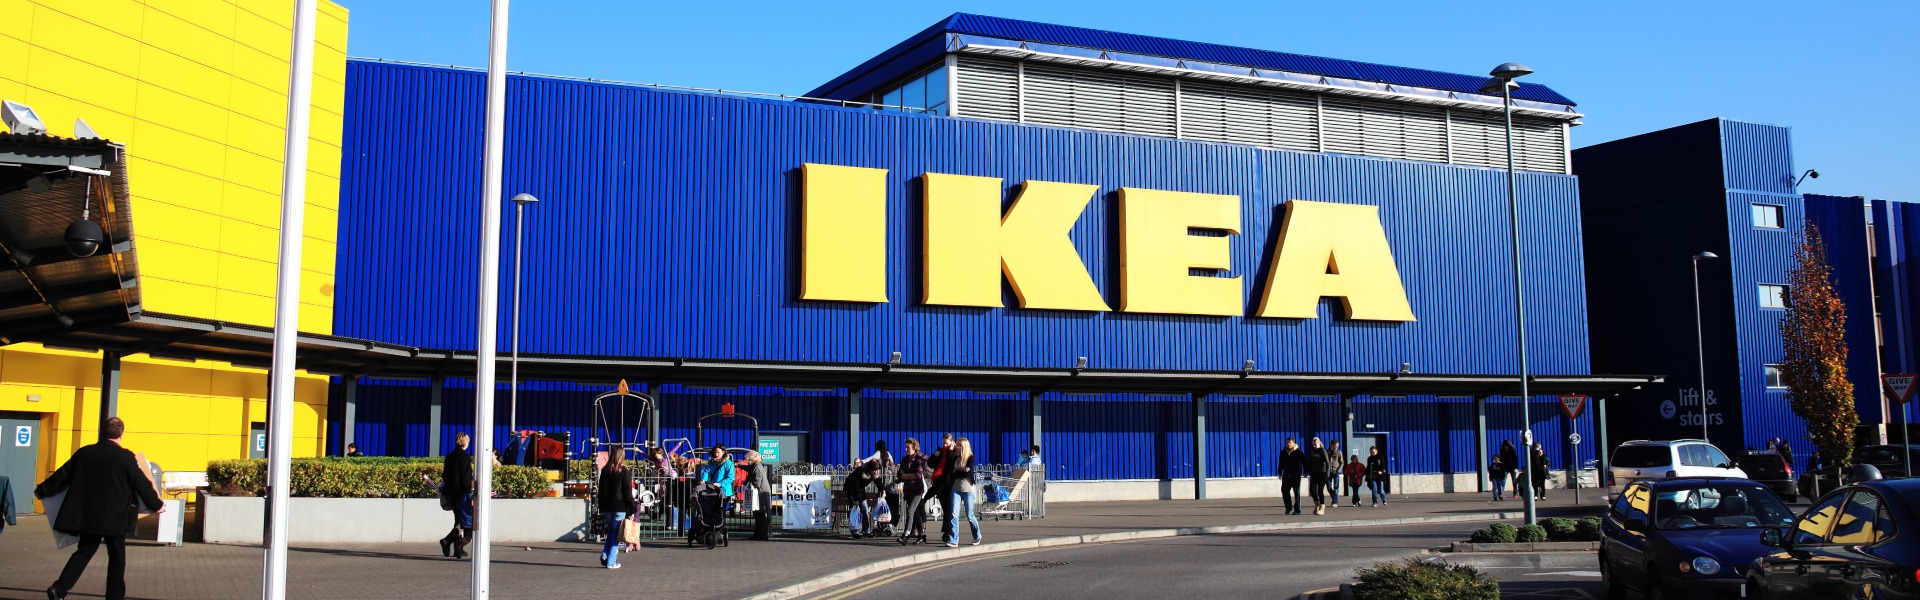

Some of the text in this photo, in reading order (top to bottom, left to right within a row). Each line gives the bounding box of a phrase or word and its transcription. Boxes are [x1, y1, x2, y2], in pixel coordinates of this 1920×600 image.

[799, 163, 1417, 322] IKEA
[1679, 388, 1717, 406] lift &
[1680, 408, 1724, 426] stairs
[786, 481, 811, 493] Play
[786, 492, 817, 501] here!
